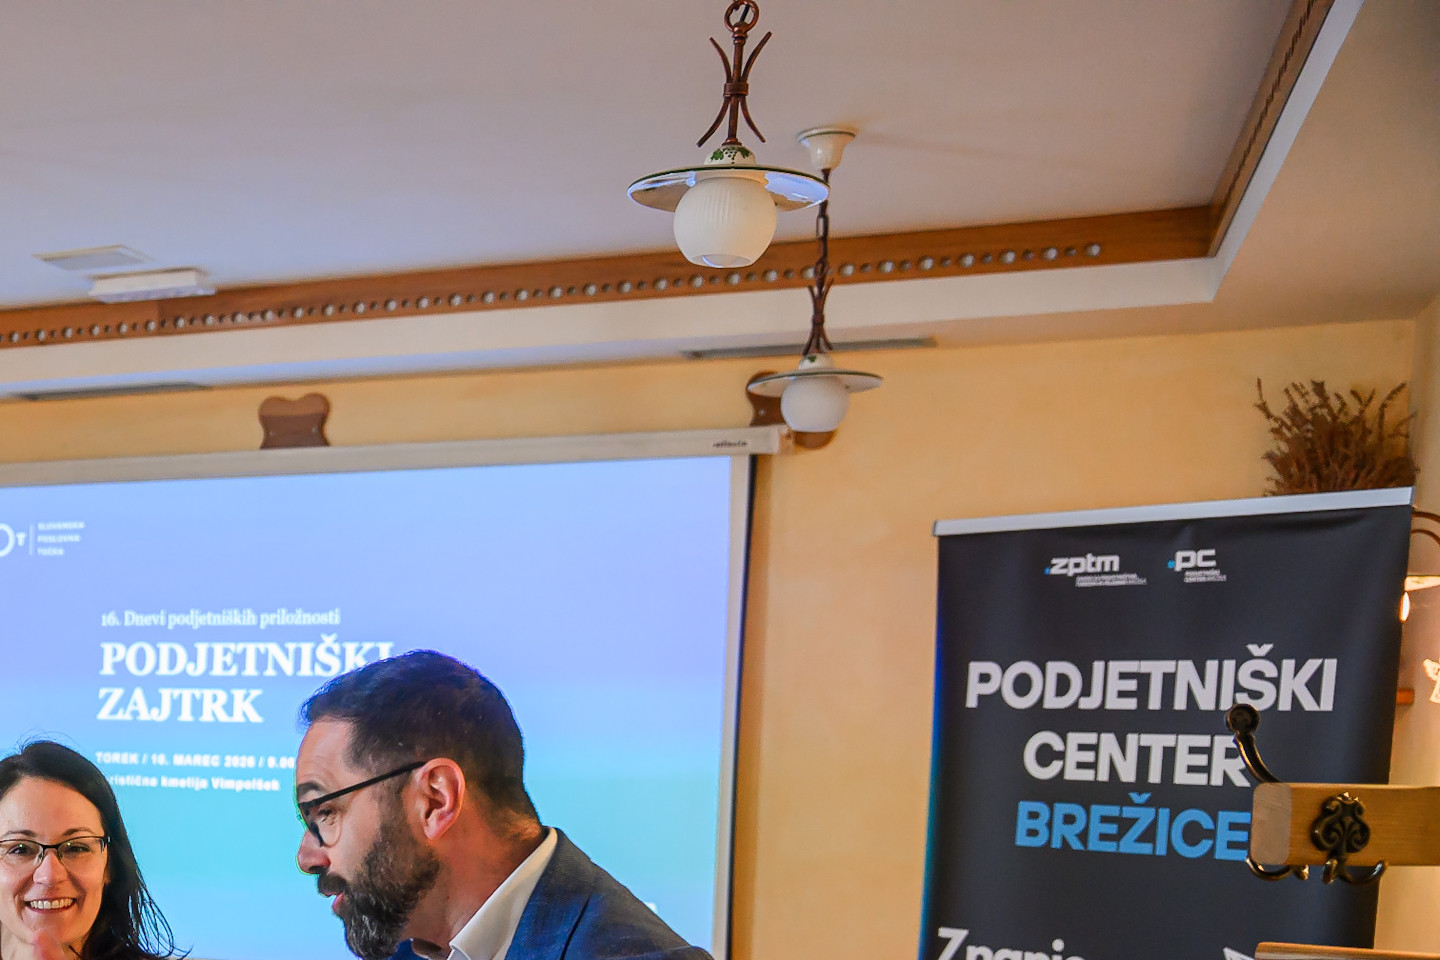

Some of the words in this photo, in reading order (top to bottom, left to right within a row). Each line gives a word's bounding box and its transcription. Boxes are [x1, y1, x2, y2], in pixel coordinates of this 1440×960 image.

[101, 611, 120, 626] 16.
[123, 610, 164, 627] Dnevi
[167, 608, 257, 629] podjetniških
[259, 608, 341, 629] priložnosti
[966, 643, 1337, 712] PODJETNIŠKI
[96, 687, 264, 722] ZAJTRK
[95, 752, 139, 765] TOREK
[173, 753, 220, 767] MAREC
[1023, 730, 1251, 787] CENTER
[109, 774, 158, 788] ristična
[1015, 792, 1251, 861] BREŽICE
